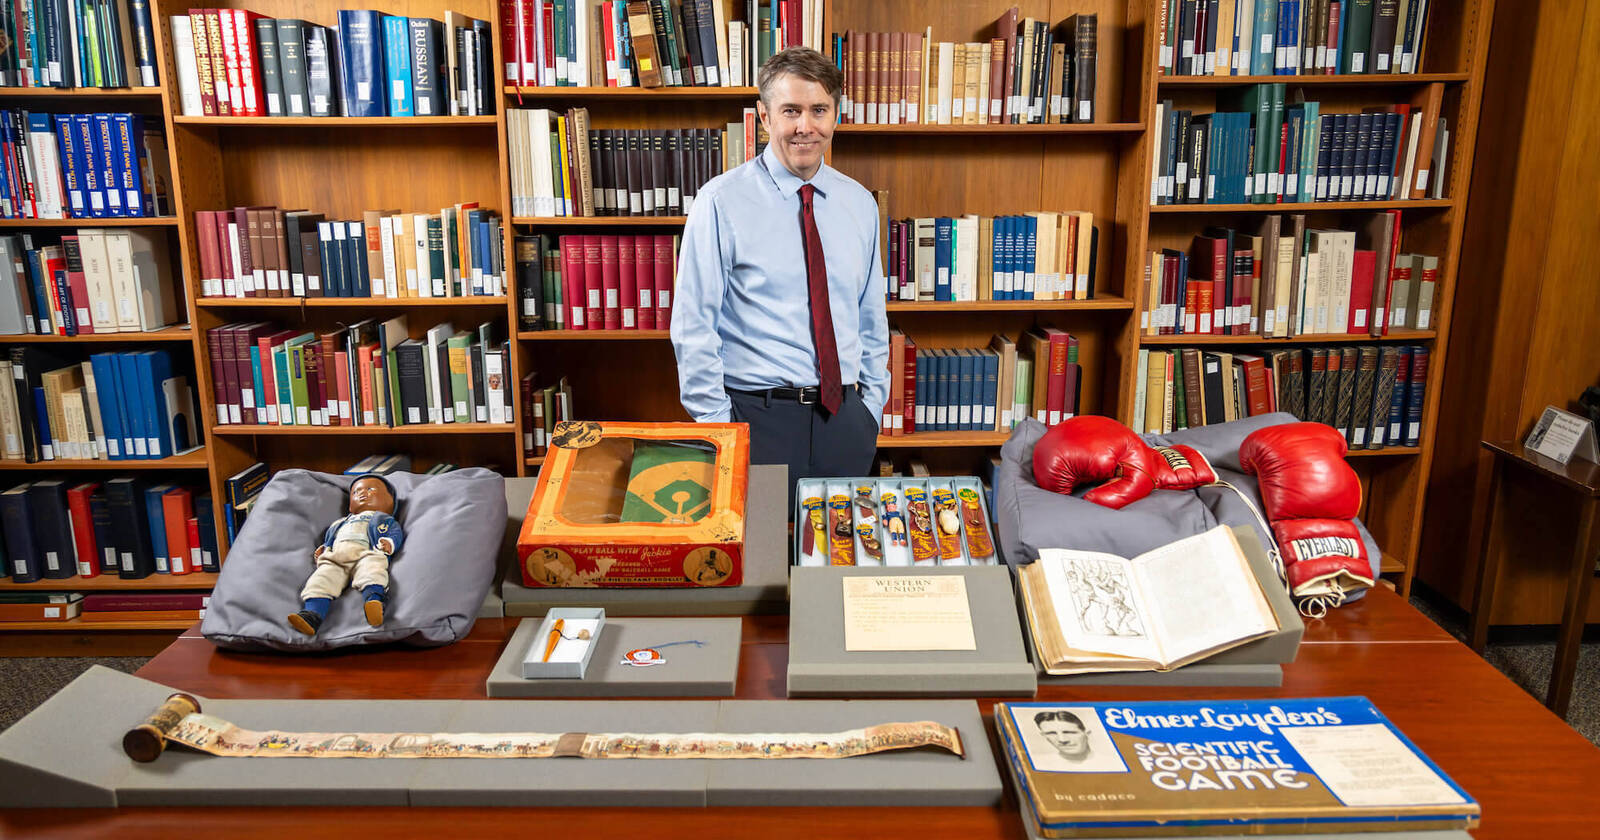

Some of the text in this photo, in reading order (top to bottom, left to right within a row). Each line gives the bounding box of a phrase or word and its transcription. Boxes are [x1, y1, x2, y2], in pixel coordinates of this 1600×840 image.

[414, 28, 430, 85] RUSSIAN
[62, 304, 71, 329] FOOTBALL
[875, 579, 932, 587] WESTERN
[1104, 706, 1343, 735] Elmer Layden's
[1133, 740, 1281, 757] SCIENTIFIC
[1138, 754, 1295, 772] FOOTBALL
[1151, 768, 1310, 791] GAME
[1054, 793, 1074, 802] by
